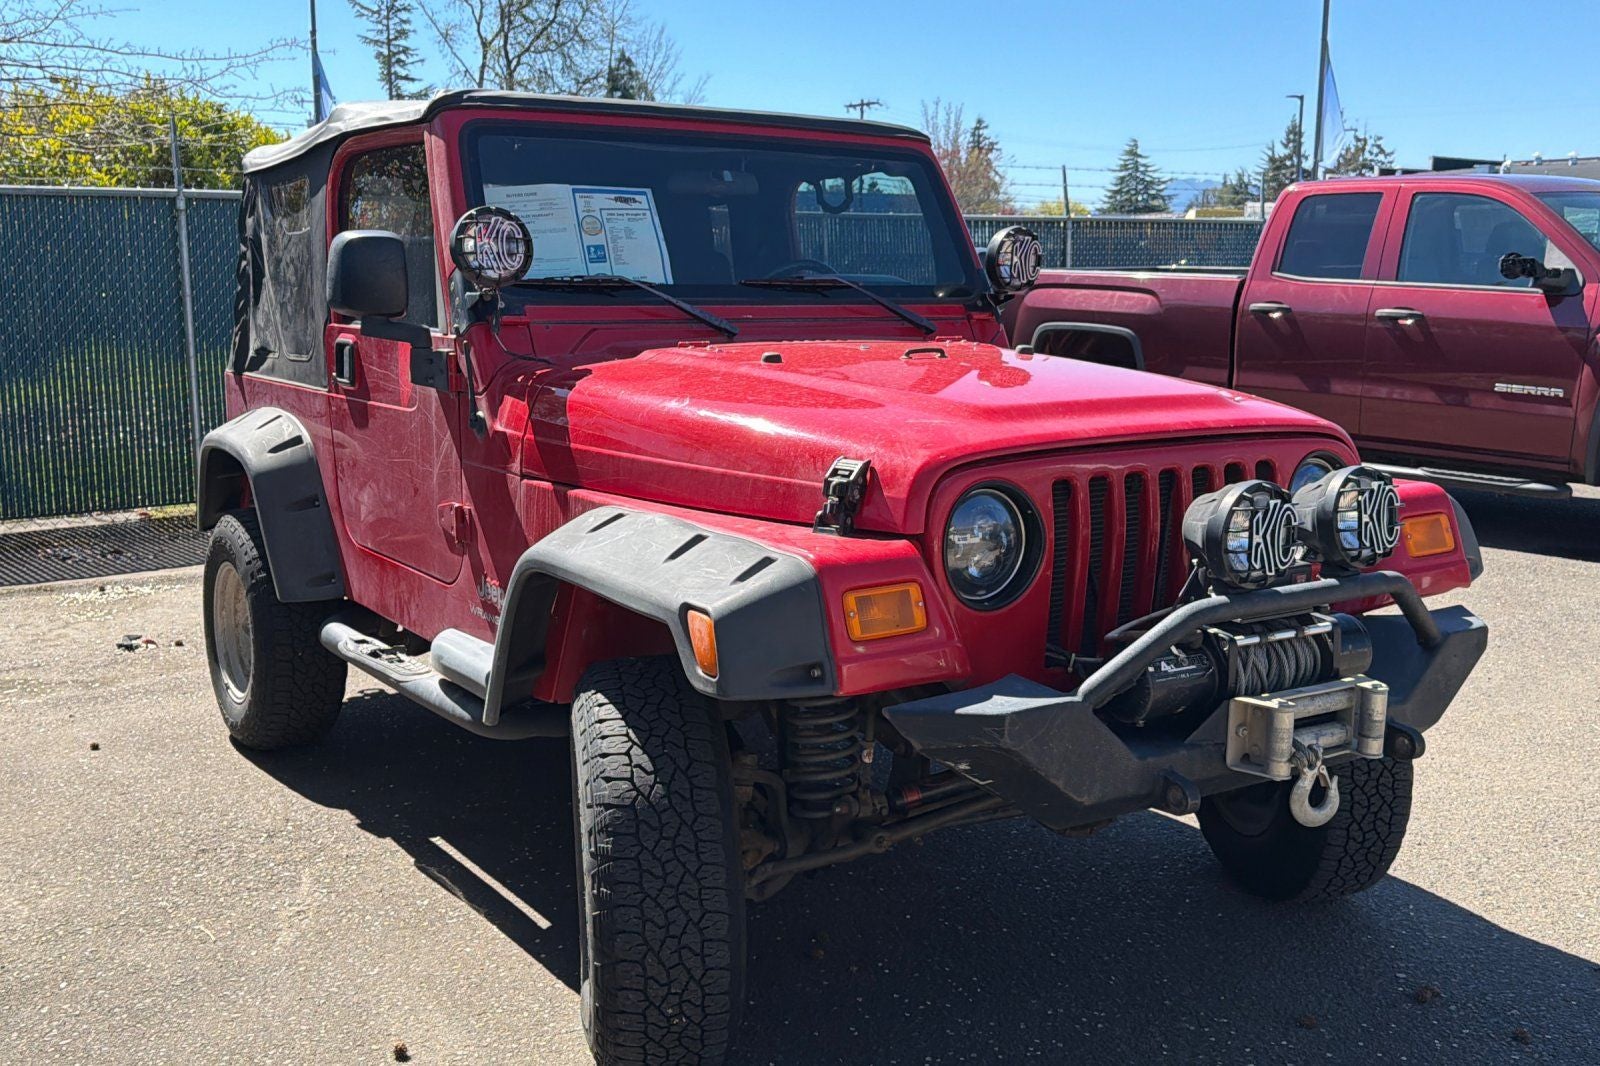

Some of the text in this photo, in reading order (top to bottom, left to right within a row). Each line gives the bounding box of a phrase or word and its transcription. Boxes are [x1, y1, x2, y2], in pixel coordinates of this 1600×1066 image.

[476, 216, 525, 274] KC
[1012, 236, 1042, 284] KC
[1493, 382, 1565, 398] SIERRA
[1251, 499, 1298, 576] KC
[1361, 481, 1401, 554] KC
[468, 600, 500, 625] WRANG
[477, 575, 505, 613] Jeep
